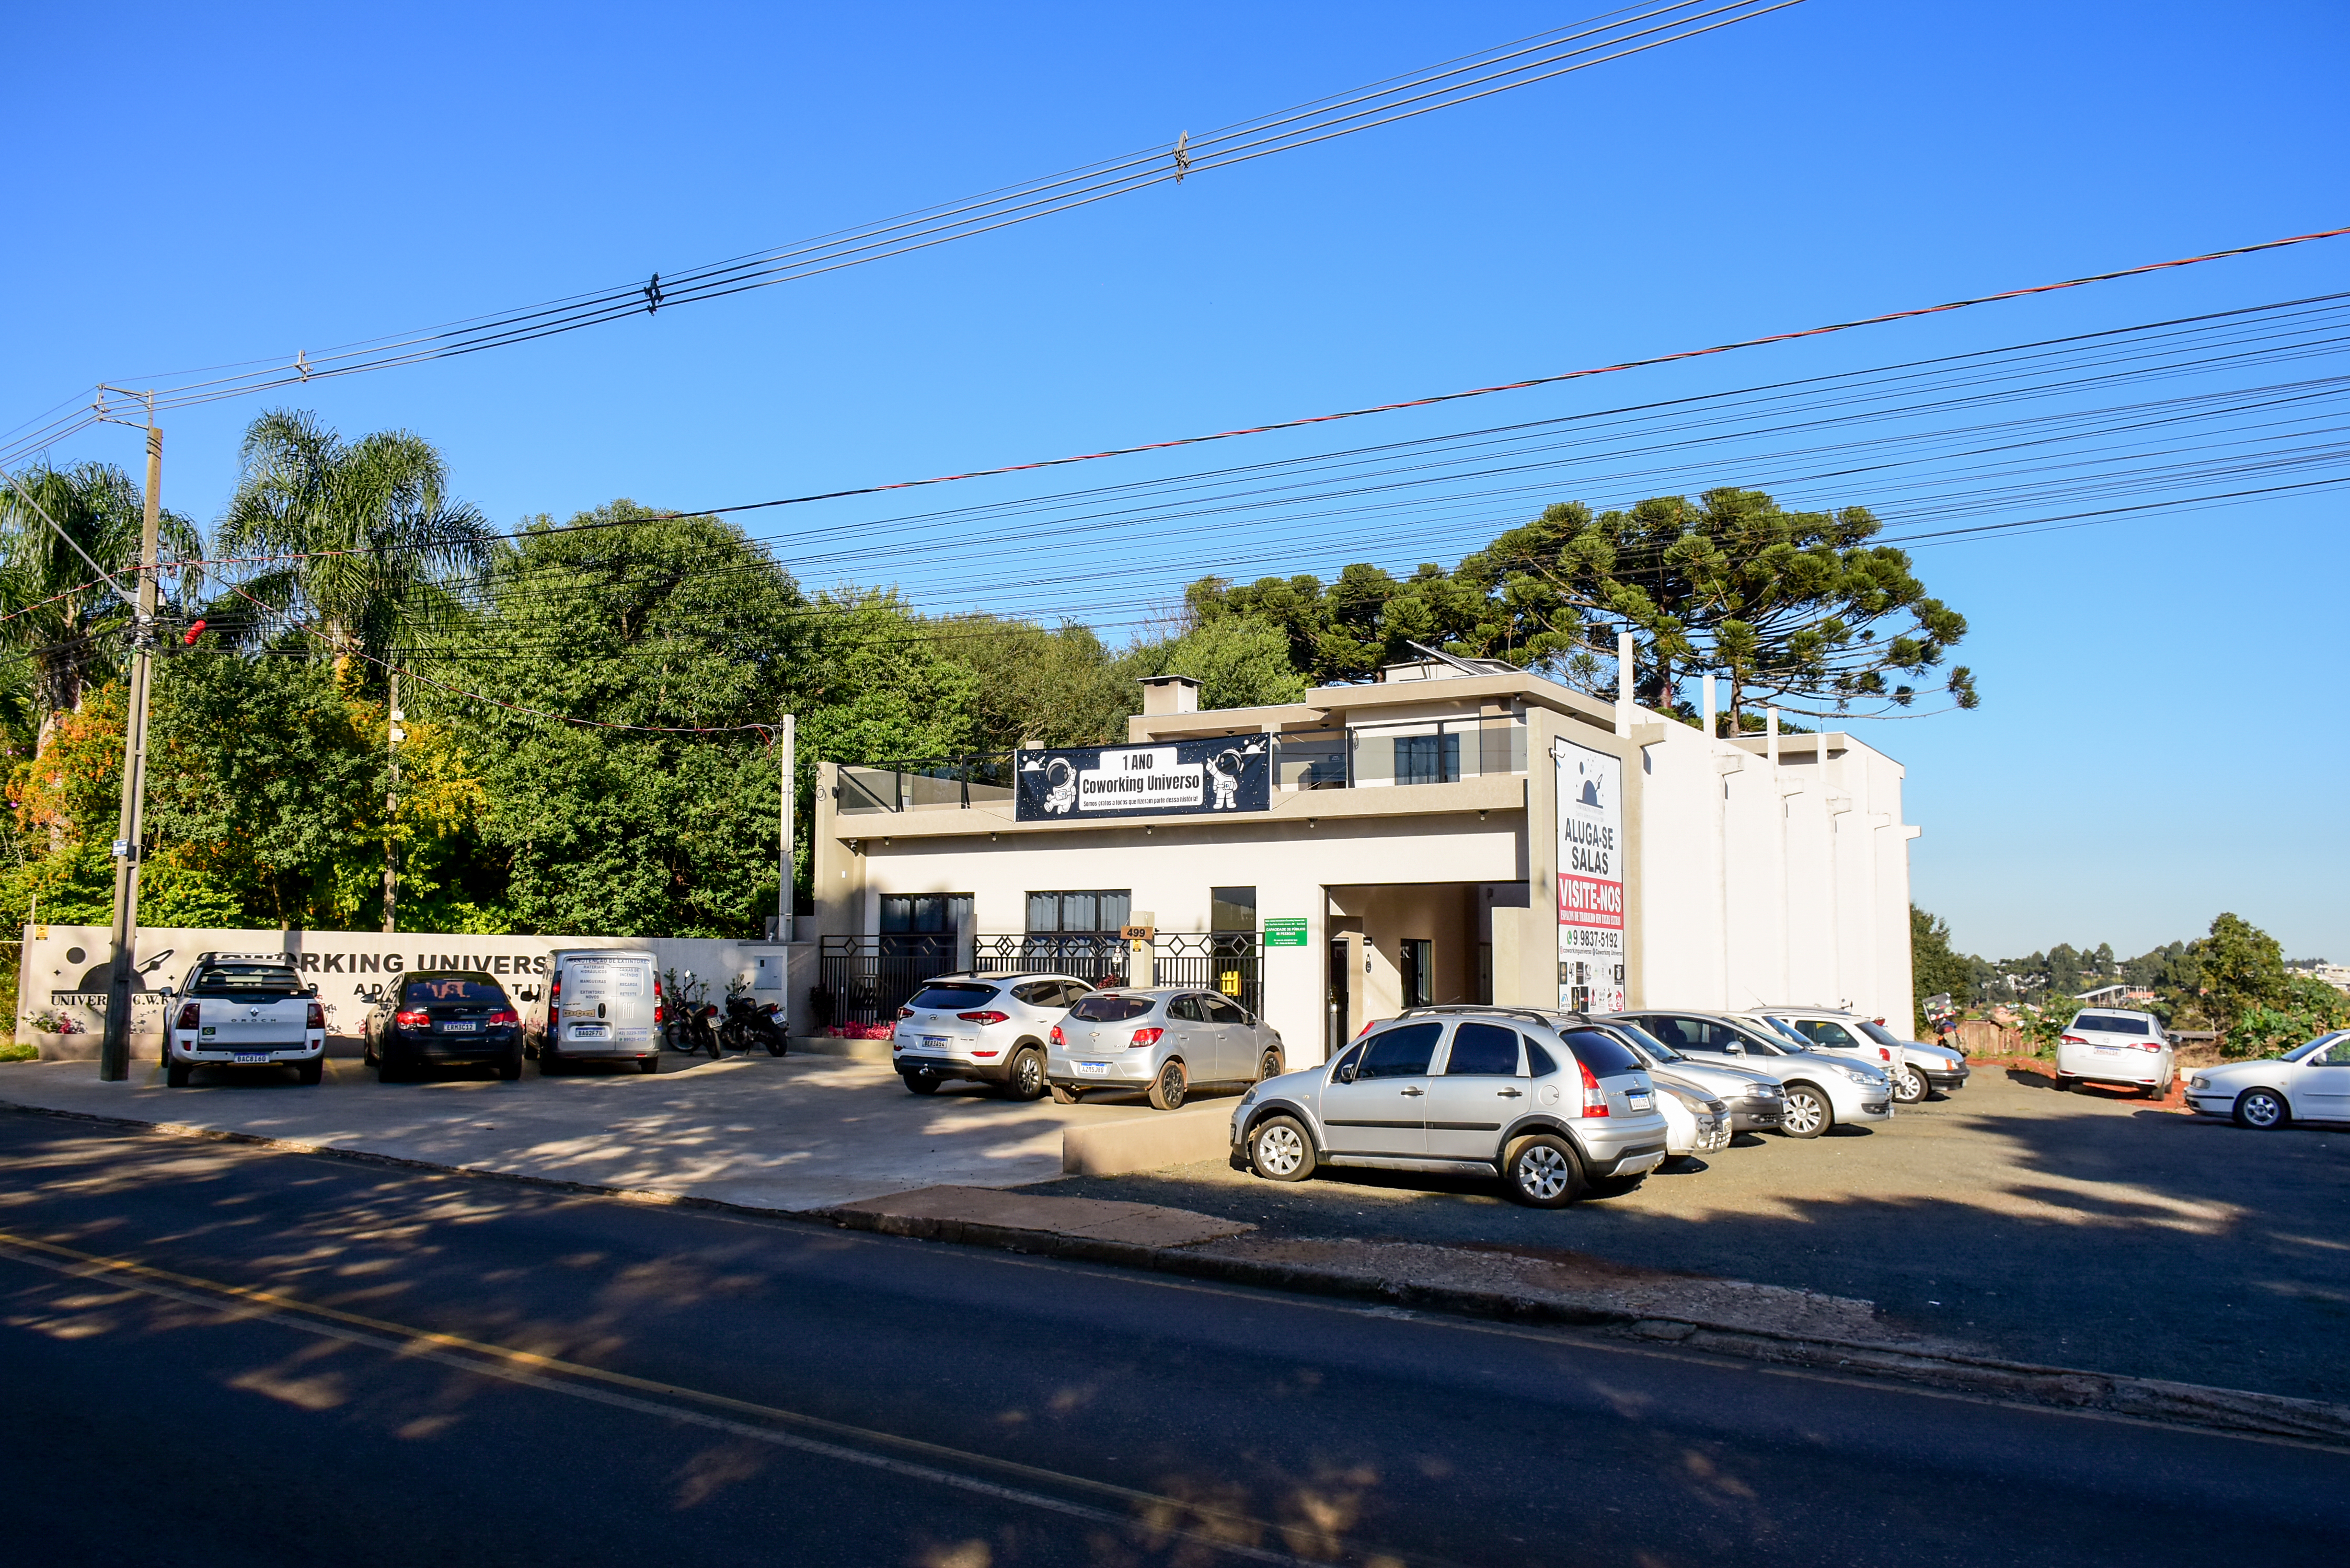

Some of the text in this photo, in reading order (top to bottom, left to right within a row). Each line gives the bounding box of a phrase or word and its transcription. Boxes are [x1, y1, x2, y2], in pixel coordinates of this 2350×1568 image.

[1123, 753, 1153, 770] 1 ANO
[1082, 774, 1200, 794] Coworking Universo
[1565, 817, 1614, 850] ALUGA-SE
[1572, 846, 1608, 875] SALAS
[1559, 878, 1621, 913] VISITE-NOS
[1127, 928, 1145, 938] 499
[1573, 929, 1618, 948] 9 9837-5192
[418, 954, 547, 975] UNIVERS
[51, 995, 107, 1006] UNIVER
